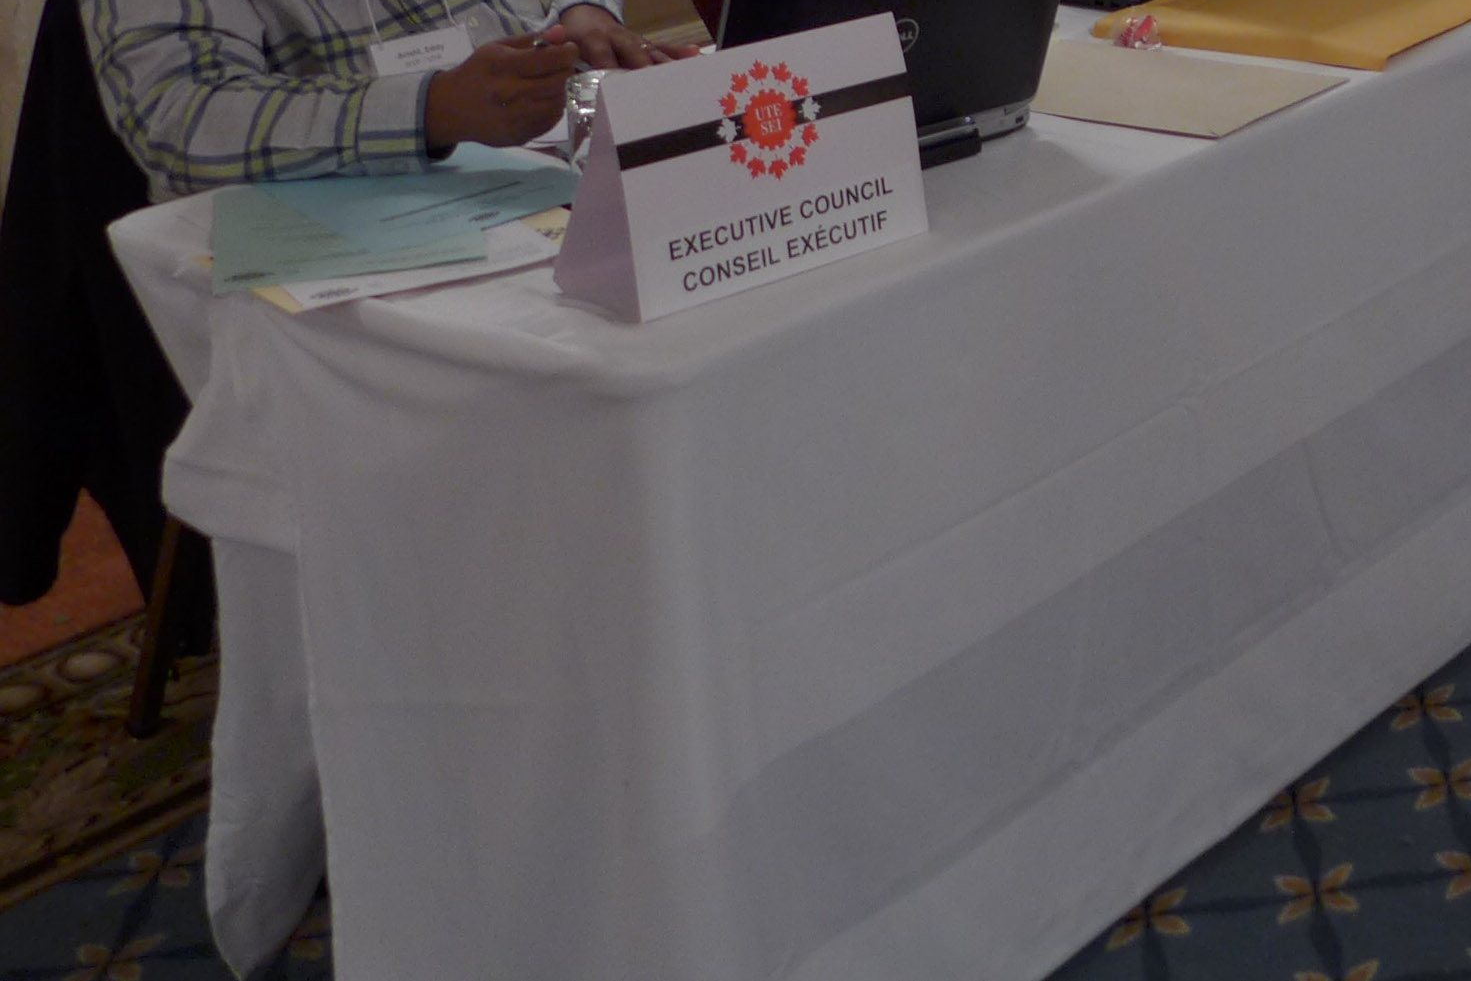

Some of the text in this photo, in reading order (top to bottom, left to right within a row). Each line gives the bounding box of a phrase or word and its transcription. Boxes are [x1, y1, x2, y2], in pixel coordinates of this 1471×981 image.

[755, 102, 783, 122] UTE
[760, 117, 783, 136] SEI
[668, 176, 894, 261] EXECUTIVE COUNCIL
[682, 210, 888, 292] CONSEIL EXÉCUTIF
